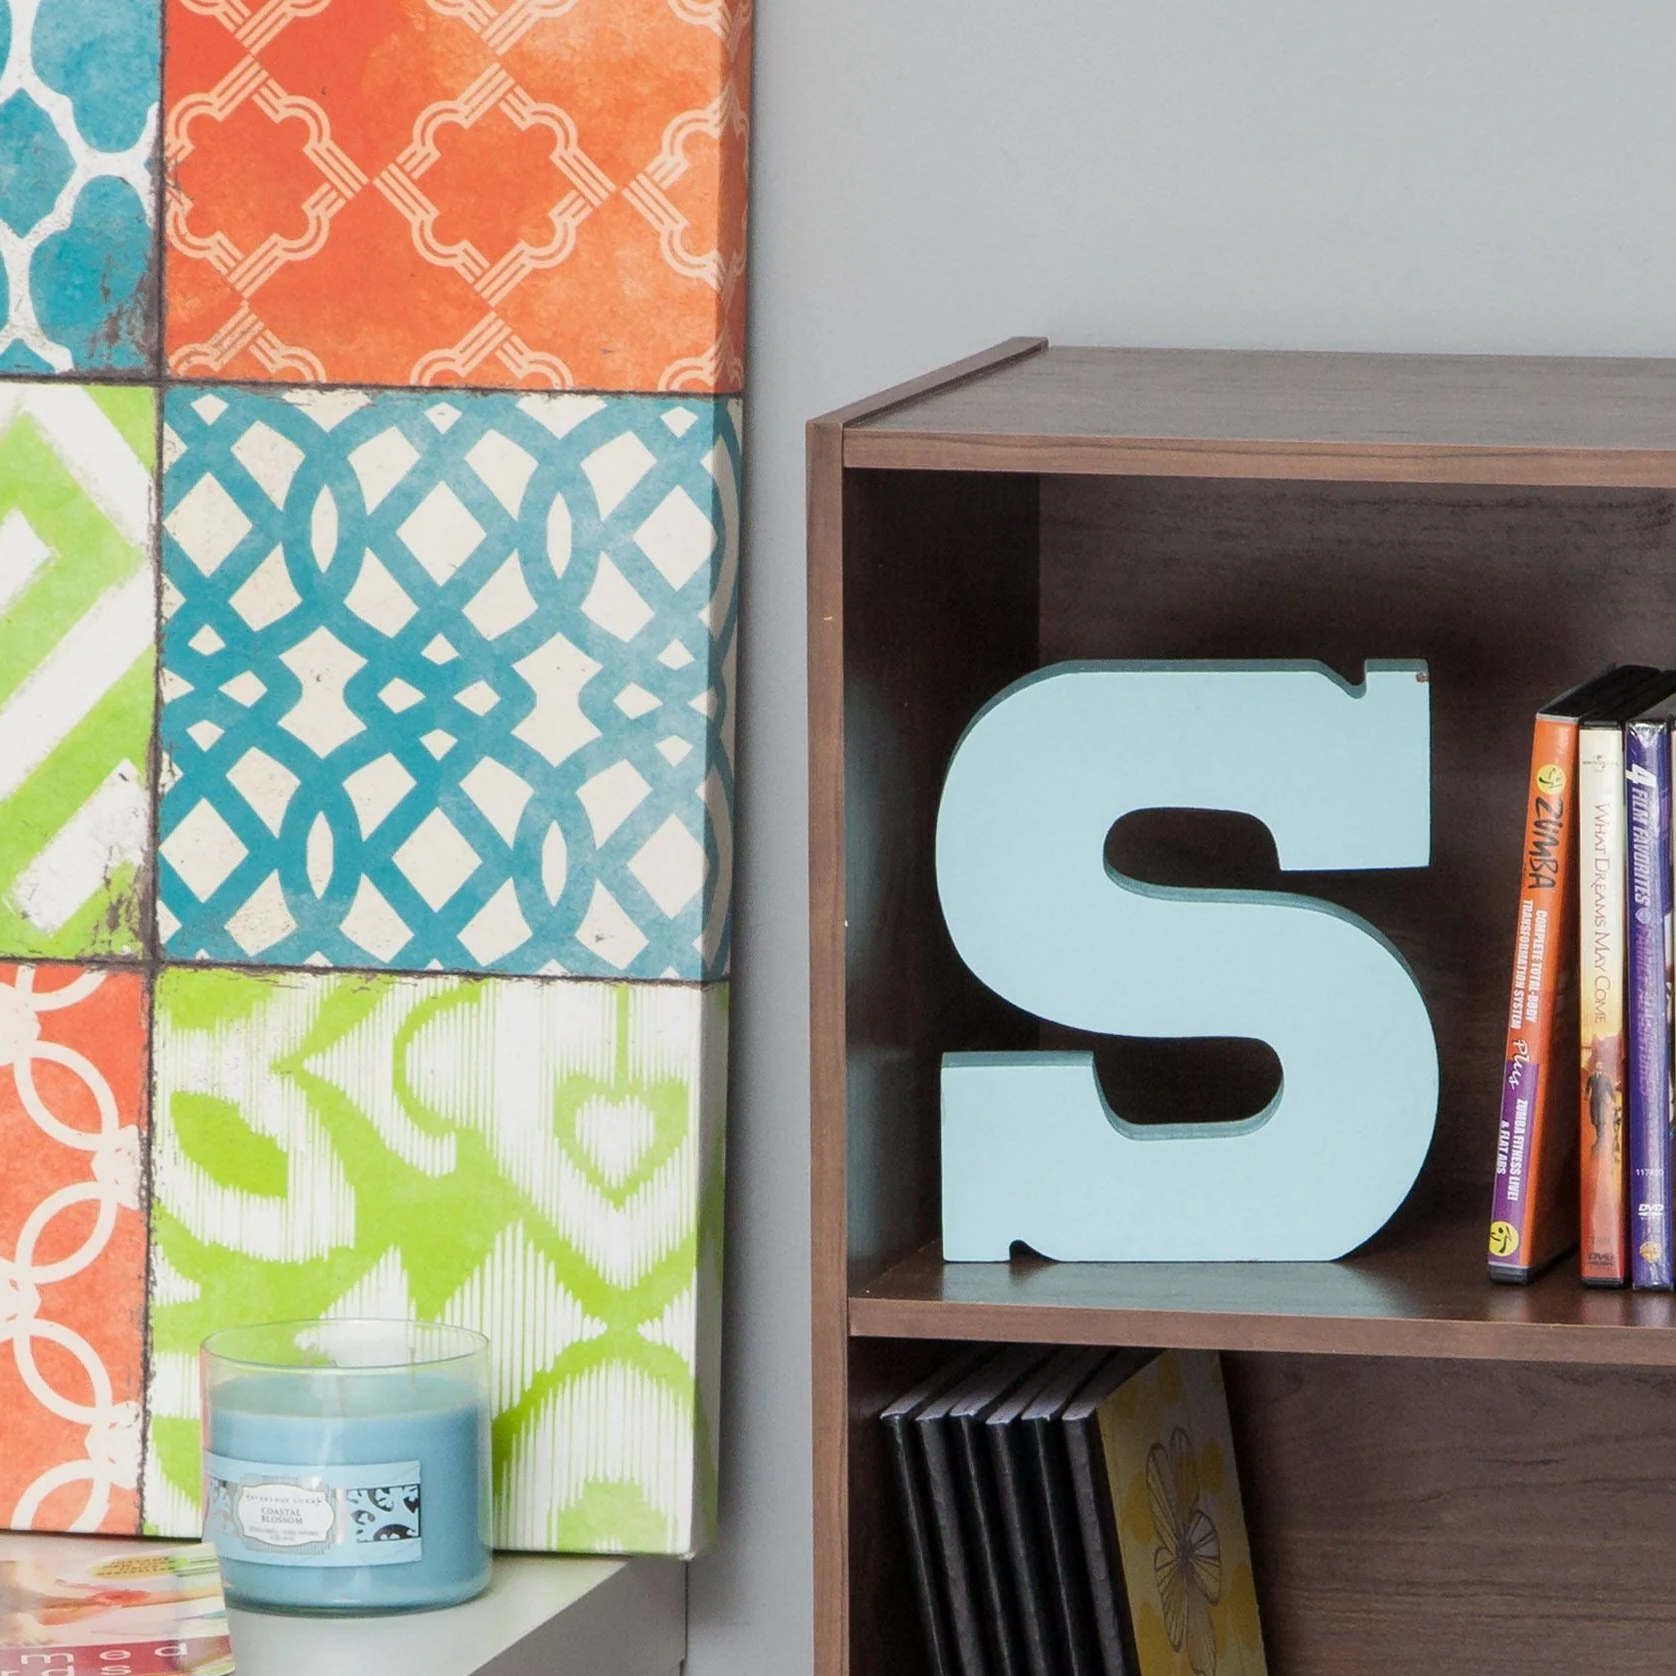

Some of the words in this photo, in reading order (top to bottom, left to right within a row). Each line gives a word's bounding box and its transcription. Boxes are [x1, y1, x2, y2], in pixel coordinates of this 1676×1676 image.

[1625, 763, 1658, 788] 4
[1593, 803, 1611, 857] WHAT
[1632, 786, 1652, 822] FILM
[1528, 796, 1564, 890] ZUMBA
[1633, 822, 1652, 906] FAVORITES
[1590, 857, 1611, 930] DREAMS
[935, 658, 1440, 1262] S
[1515, 899, 1533, 989] TRANSFORMATION
[1532, 910, 1547, 961] COMPLETE
[1593, 931, 1611, 974] MAY
[1510, 990, 1525, 1030] SYSTEM
[1593, 975, 1611, 1025] COME
